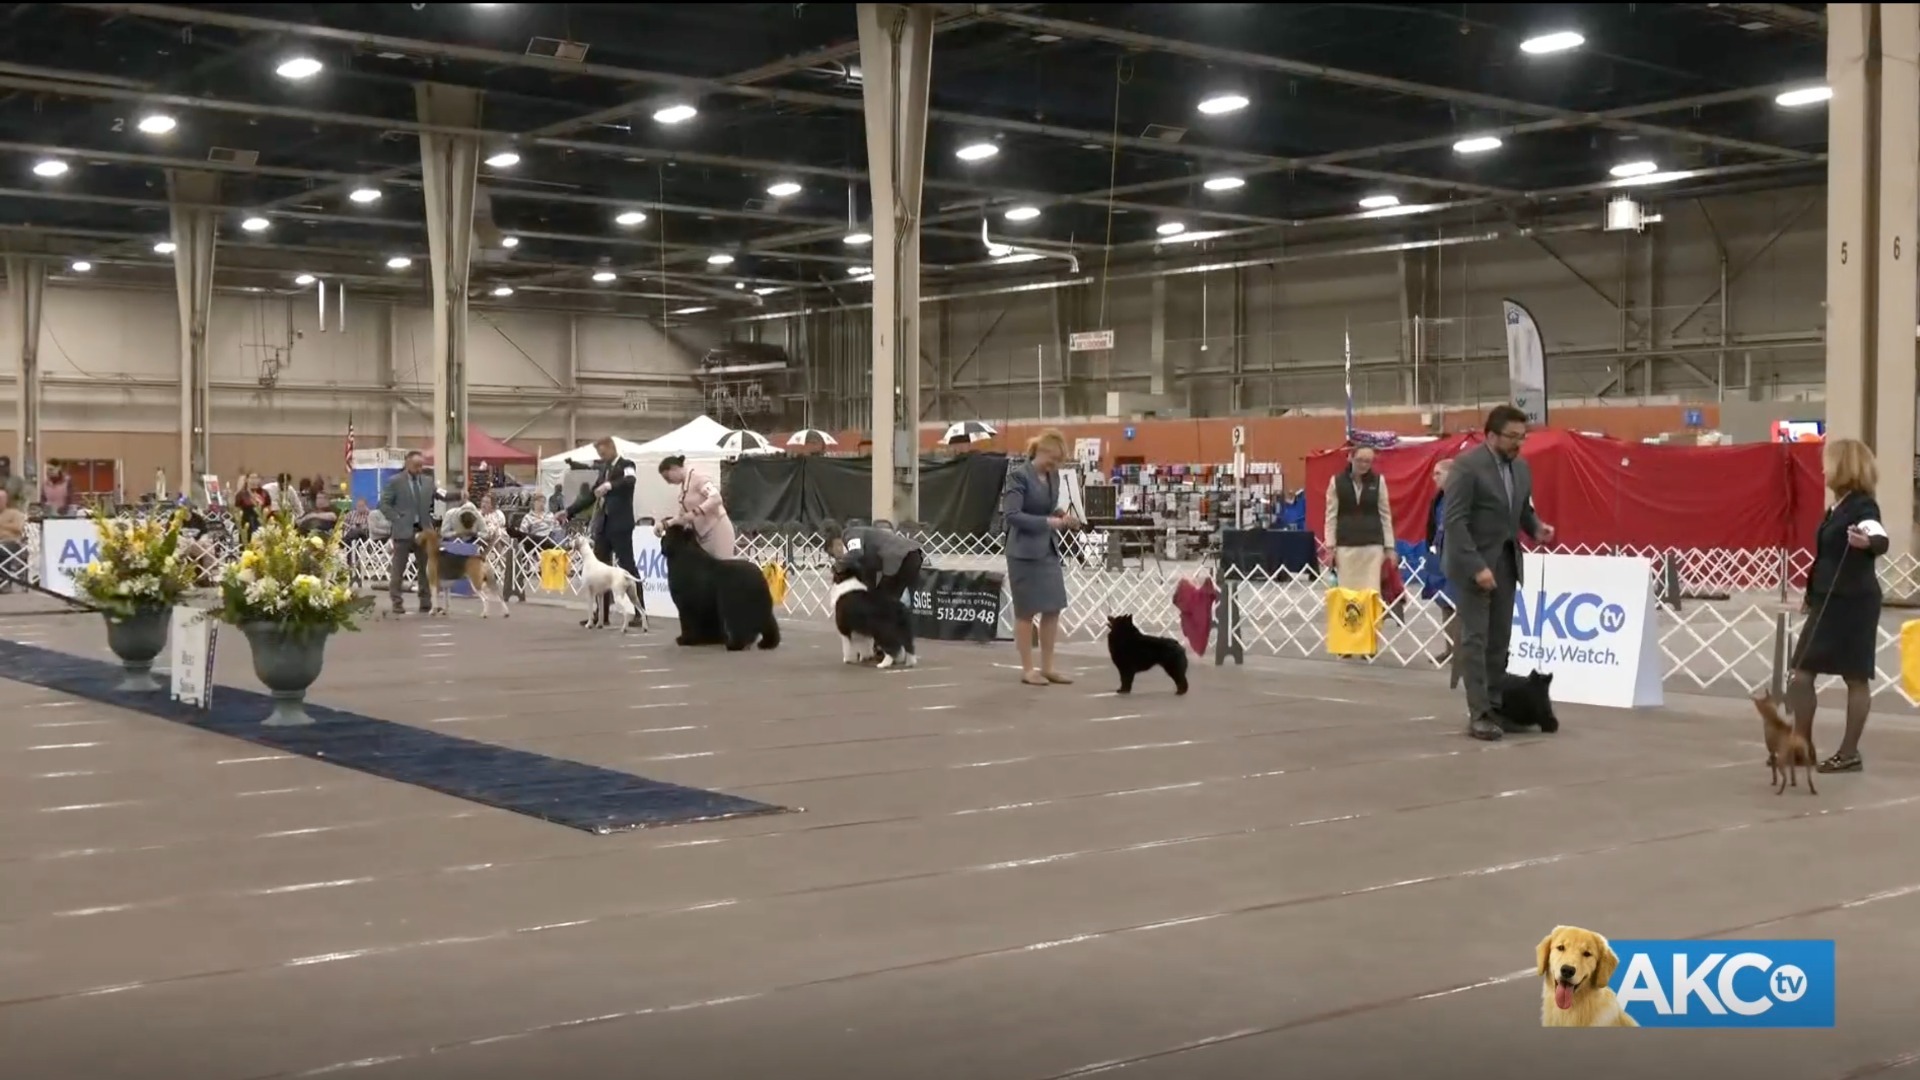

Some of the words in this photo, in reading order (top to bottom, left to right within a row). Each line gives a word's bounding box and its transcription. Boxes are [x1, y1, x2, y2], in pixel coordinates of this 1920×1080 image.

[111, 117, 124, 132] 2
[1841, 241, 1848, 265] 5
[1893, 235, 1901, 260] 6
[1233, 428, 1241, 445] 9
[58, 538, 102, 564] AK
[1512, 590, 1604, 642] AKC
[1602, 608, 1623, 628] tv
[1518, 642, 1557, 663] Stay.
[1560, 645, 1619, 666] Watch.
